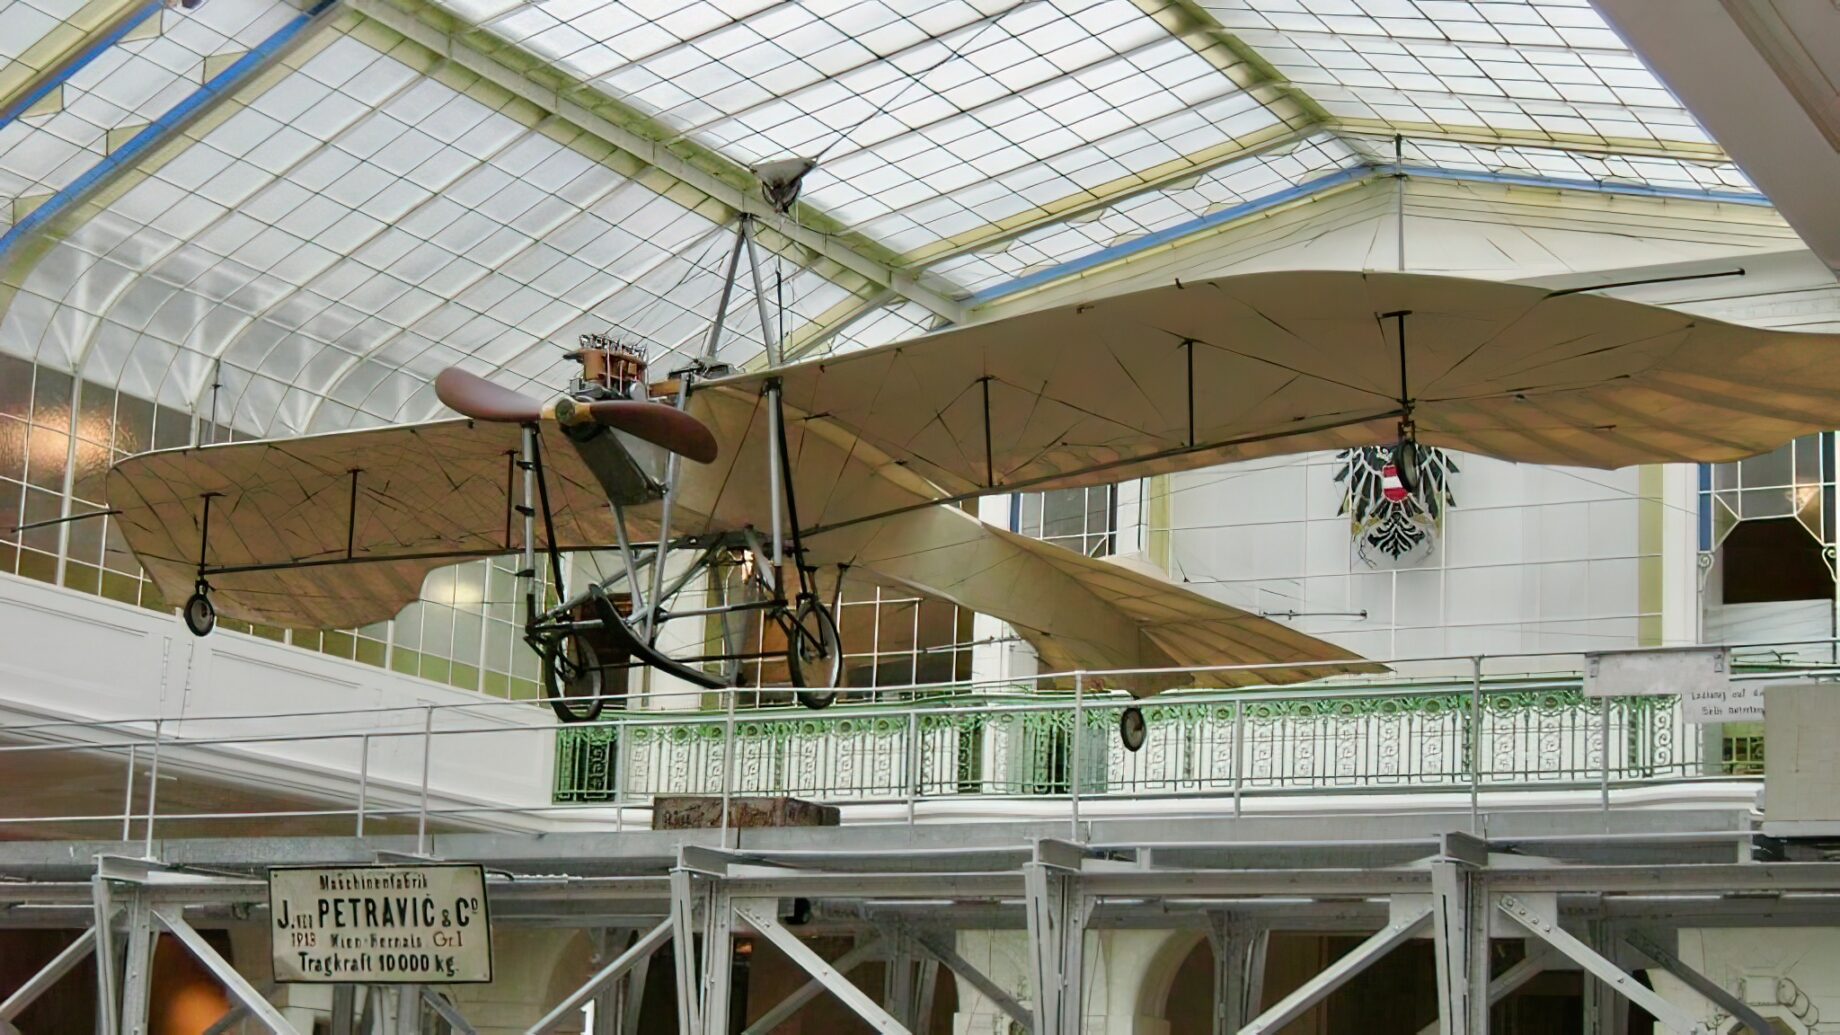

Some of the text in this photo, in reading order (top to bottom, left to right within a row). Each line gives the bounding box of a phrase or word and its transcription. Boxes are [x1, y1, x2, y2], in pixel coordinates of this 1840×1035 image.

[319, 872, 428, 891] Maschinenfabrik
[298, 951, 372, 977] Tragkraft
[379, 954, 430, 972] 10000
